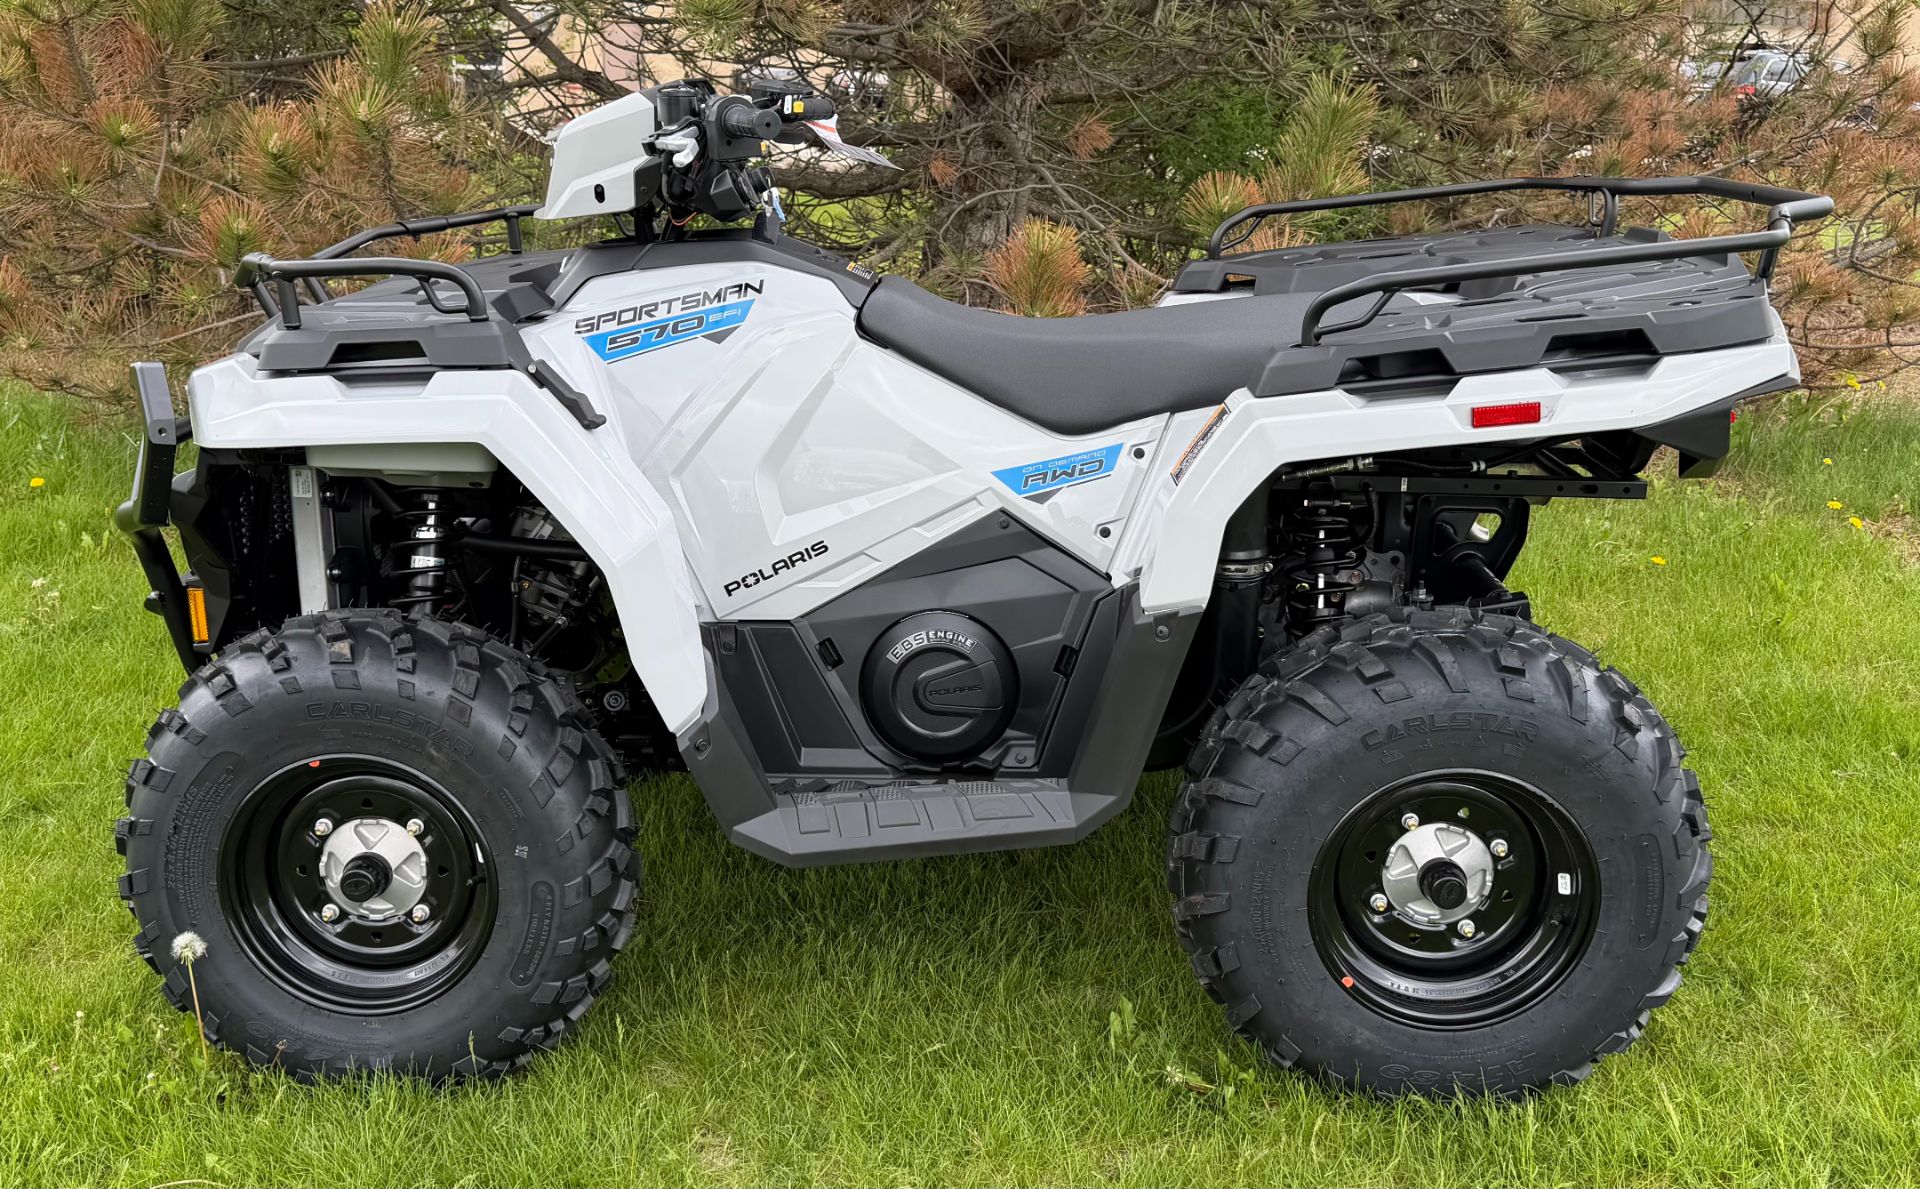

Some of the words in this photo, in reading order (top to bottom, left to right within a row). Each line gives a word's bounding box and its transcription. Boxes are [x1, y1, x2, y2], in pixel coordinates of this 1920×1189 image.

[574, 279, 764, 335] SPORTSMAN
[606, 314, 705, 353] 570
[708, 309, 742, 322] EFI
[1022, 458, 1105, 489] AWD
[723, 540, 829, 597] POLARIS
[889, 632, 926, 661] EBS
[928, 630, 974, 648] ENGINE
[928, 684, 983, 697] POLARIS
[305, 701, 475, 760] CARLSTAR
[1360, 711, 1540, 751] CARLSTAR
